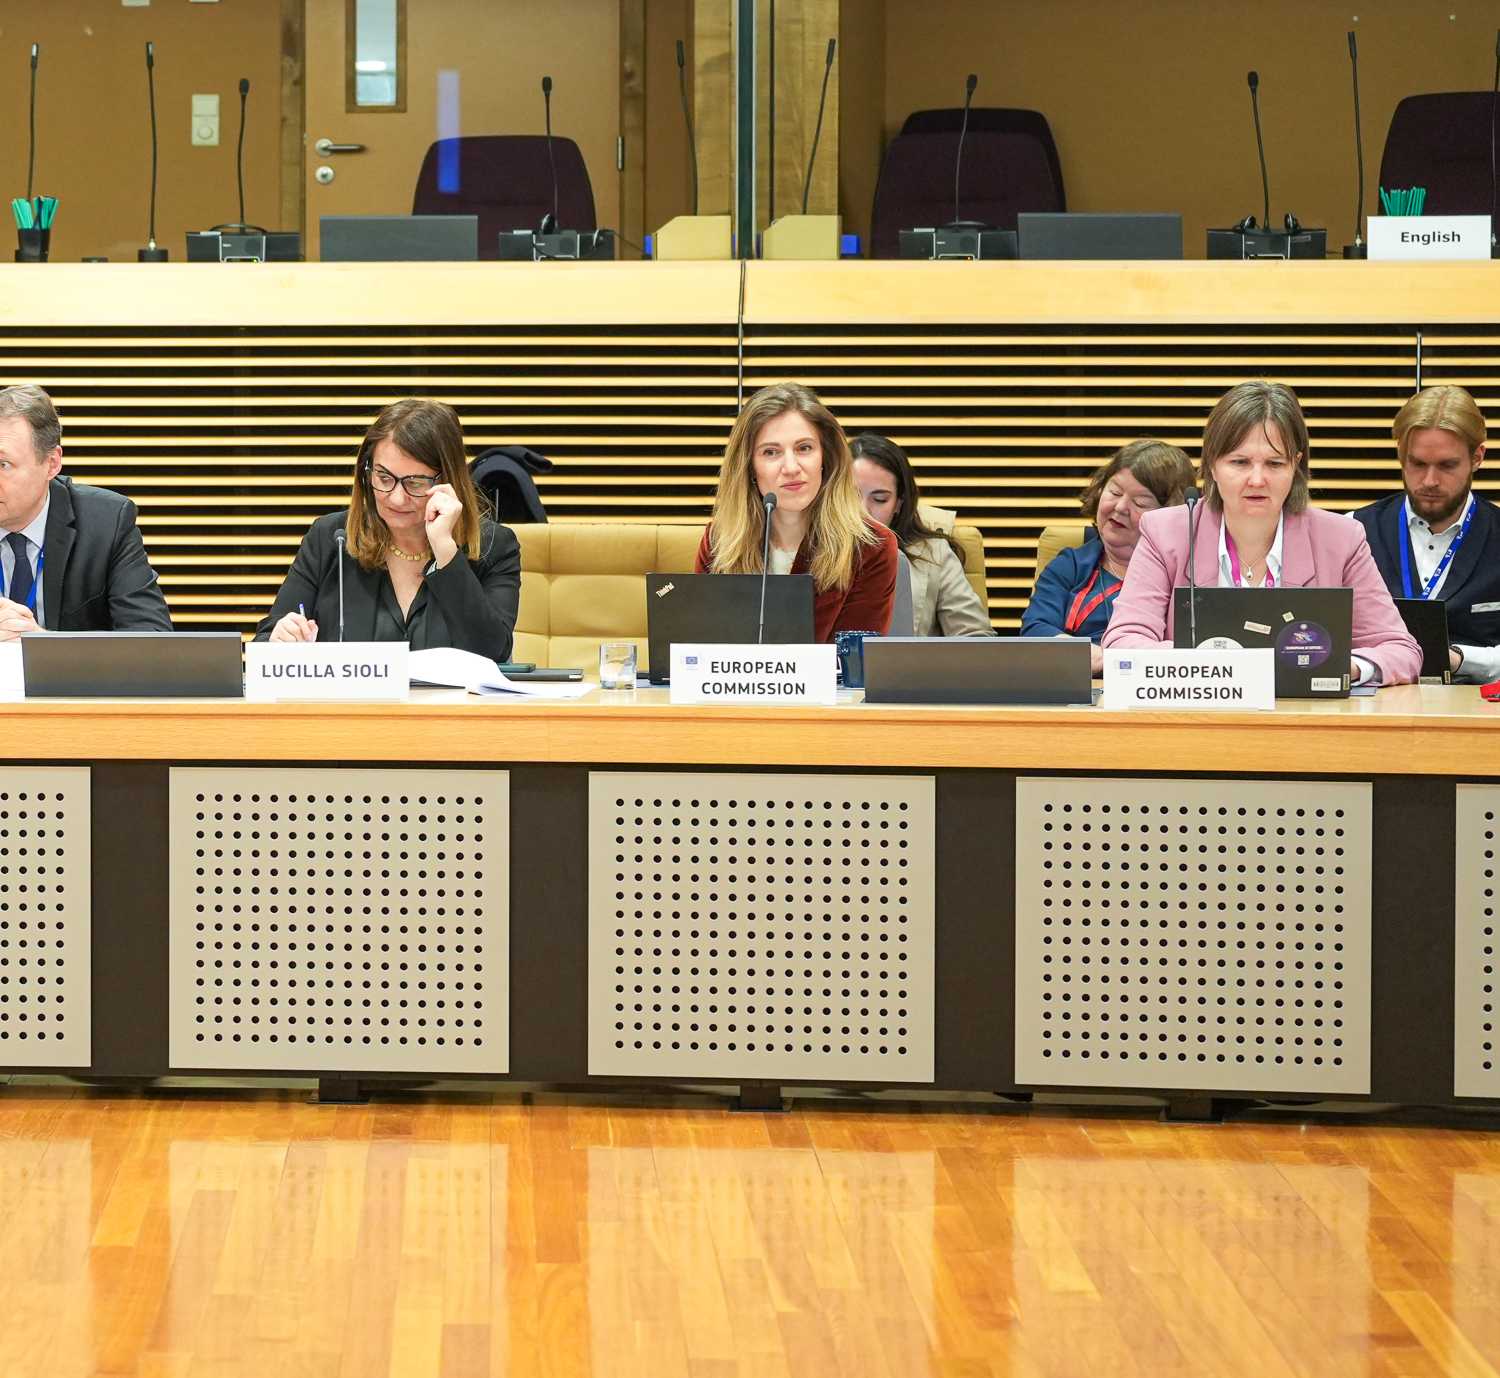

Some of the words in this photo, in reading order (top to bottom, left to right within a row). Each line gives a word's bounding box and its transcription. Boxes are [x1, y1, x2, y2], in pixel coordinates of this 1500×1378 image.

[1400, 231, 1461, 246] English
[655, 582, 675, 598] ThinkPad
[262, 664, 335, 678] LUCILLA
[342, 664, 388, 678] SIOLI
[711, 661, 796, 674] EUROPEAN
[1145, 665, 1233, 679] EUROPEAN
[701, 682, 805, 695] COMMISSION
[1136, 687, 1243, 700] COMMISSION
